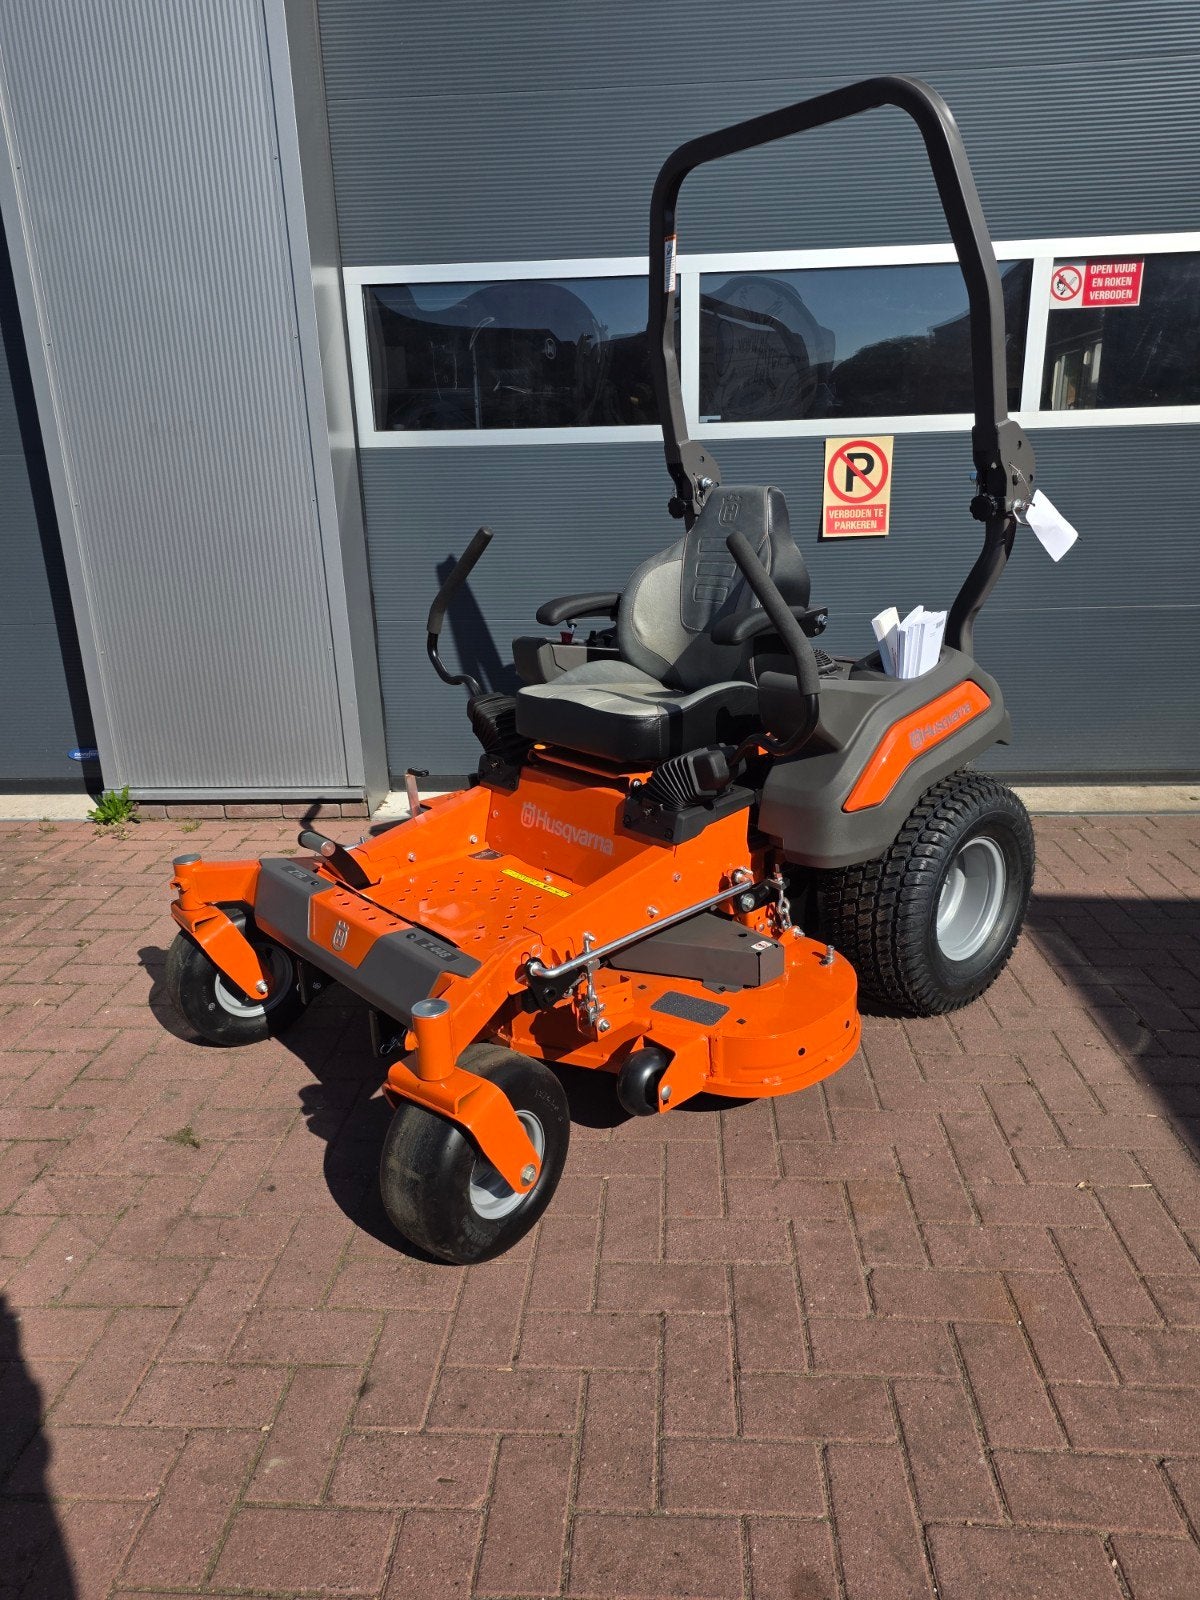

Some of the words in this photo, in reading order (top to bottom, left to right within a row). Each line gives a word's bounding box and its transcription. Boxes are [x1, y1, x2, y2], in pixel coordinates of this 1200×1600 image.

[1090, 265, 1112, 274] OPEN
[1114, 263, 1136, 273] VUUR
[1092, 278, 1103, 287] EN
[1105, 277, 1132, 287] ROKEN
[1090, 290, 1132, 300] VERBODEN
[845, 452, 875, 492] P
[829, 509, 872, 519] VERBODEN
[873, 508, 884, 517] TE
[834, 520, 877, 530] PARKEREN
[535, 808, 614, 856] Husqvarna
